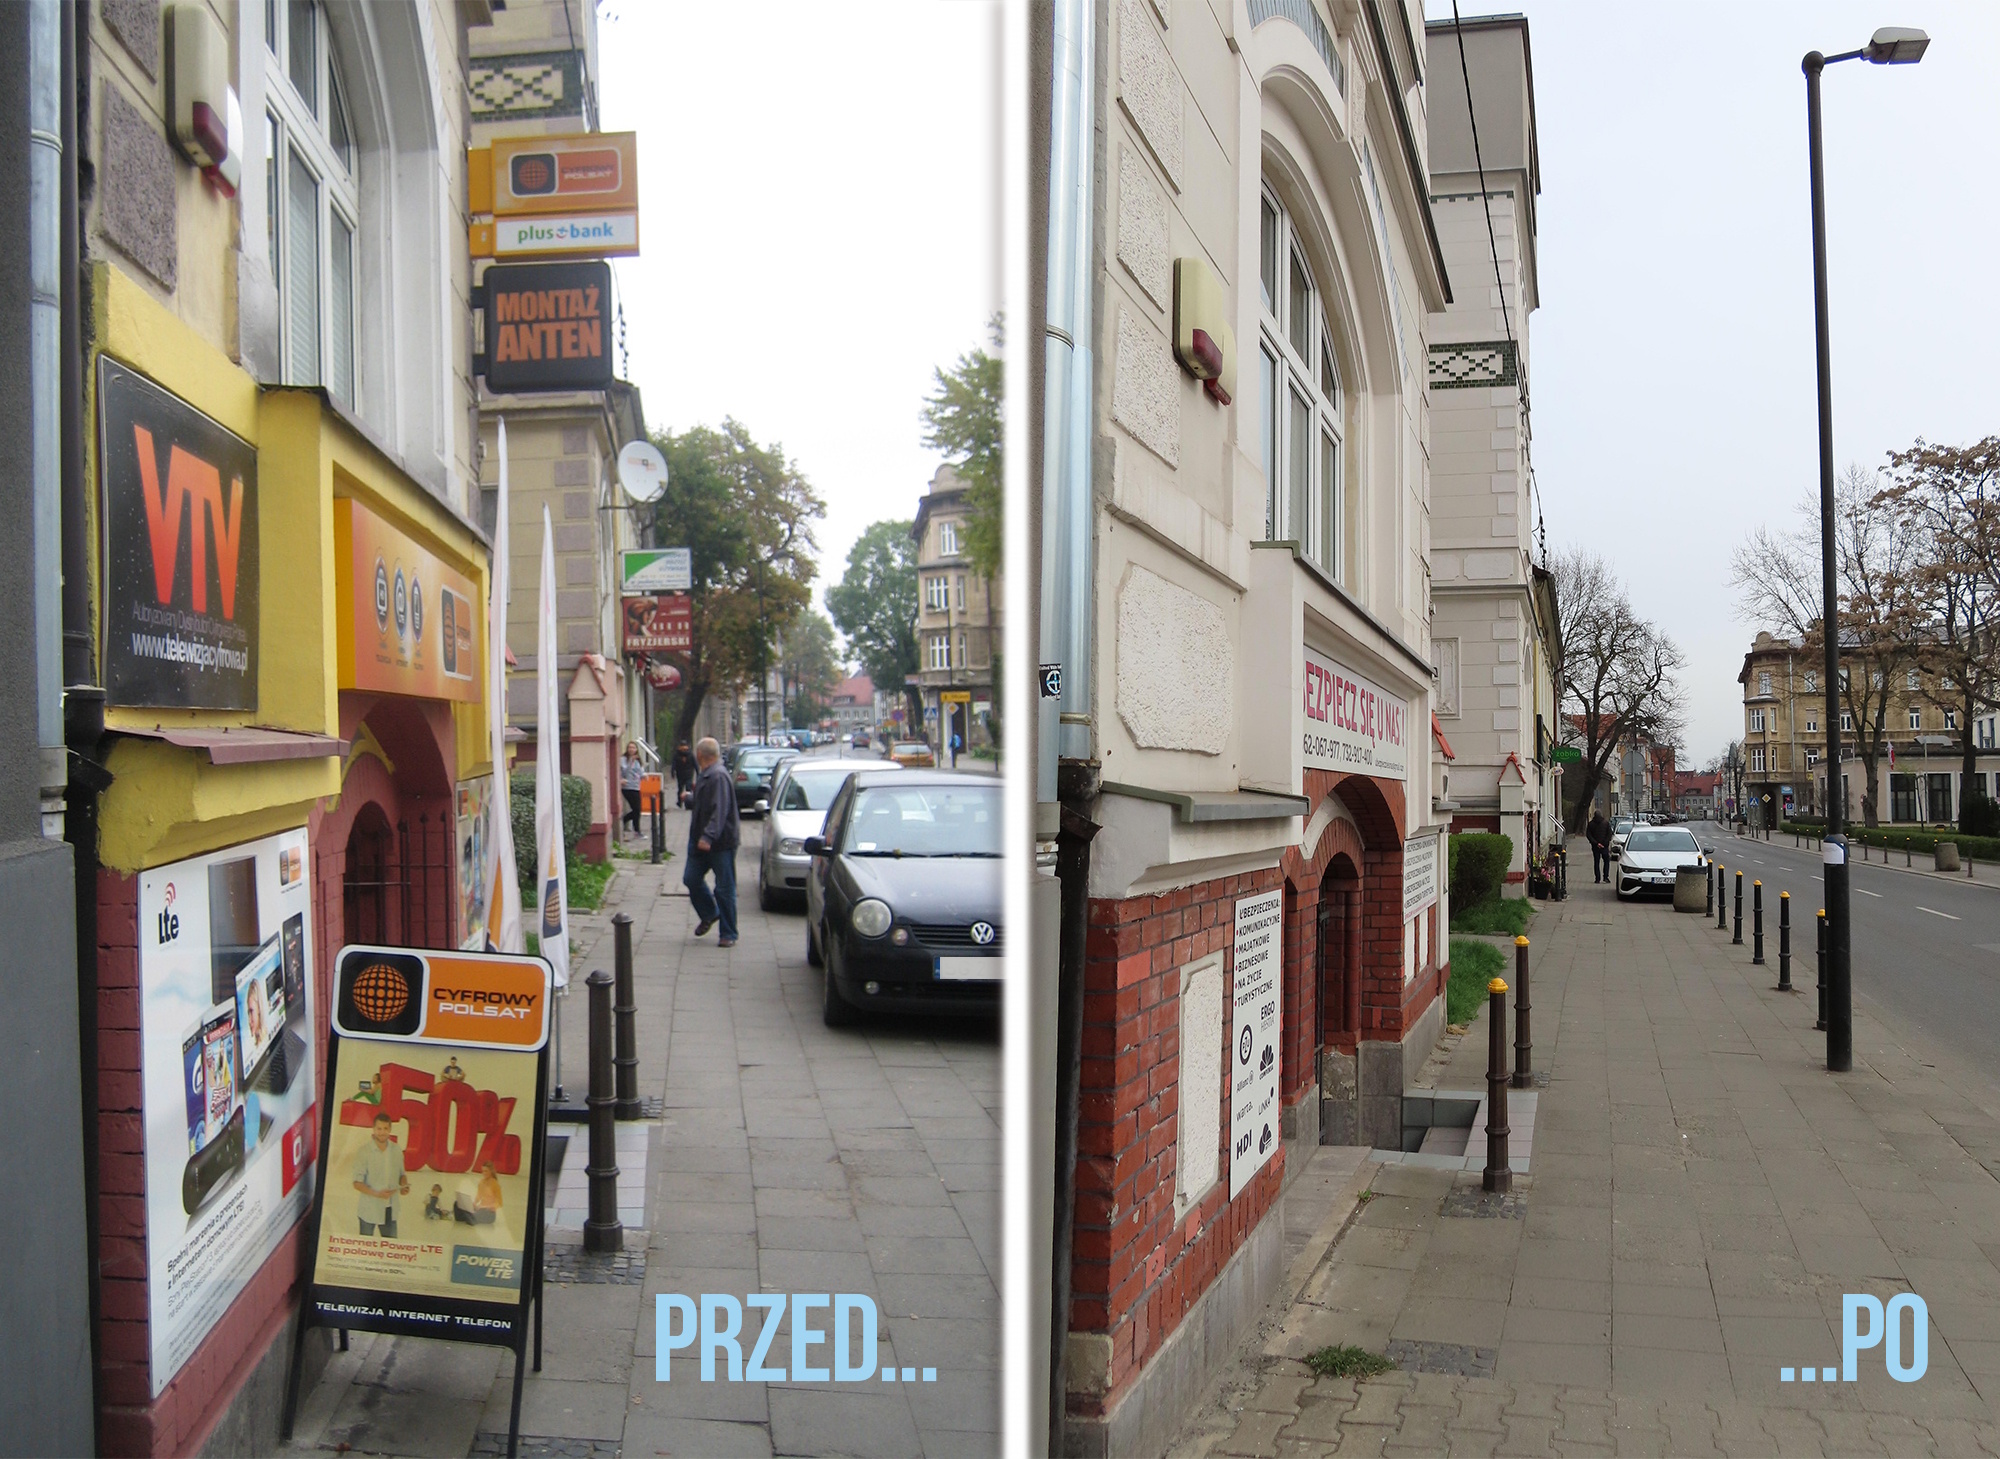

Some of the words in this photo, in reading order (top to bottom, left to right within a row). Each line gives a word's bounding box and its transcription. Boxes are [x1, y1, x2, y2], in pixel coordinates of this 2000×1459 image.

[518, 225, 554, 244] plus
[570, 222, 613, 239] bank
[496, 283, 600, 322] MONTAŻ
[496, 319, 602, 362] ANTEN
[132, 632, 249, 677] www.telewizjacyfrowa.pl
[1303, 661, 1358, 733] EZPIECZ
[1360, 688, 1375, 749] SIĘ
[1377, 697, 1384, 741] U
[1239, 913, 1280, 938] KOMUNIKACYJNE
[1238, 933, 1270, 955] MAJĄTKOWE
[1238, 950, 1269, 972] BIZNESOWE
[1237, 978, 1246, 990] NA
[1246, 969, 1262, 986] ŻYCIE
[433, 988, 537, 1007] CYFROWY
[1237, 979, 1273, 1007] TURYSTYCZNE
[438, 1002, 531, 1020] POLSAT
[1260, 1000, 1275, 1020] ERGO
[1236, 1129, 1252, 1161] HDI
[329, 1235, 379, 1248] Internet
[380, 1240, 419, 1252] Power
[420, 1244, 443, 1255] LTE
[386, 1252, 417, 1262] ceny!
[456, 1254, 514, 1269] POWER
[485, 1268, 514, 1280] LTE
[316, 1301, 384, 1316] TELEWIZJA
[388, 1309, 450, 1323] INTERNET
[455, 1316, 512, 1329] TELEFON
